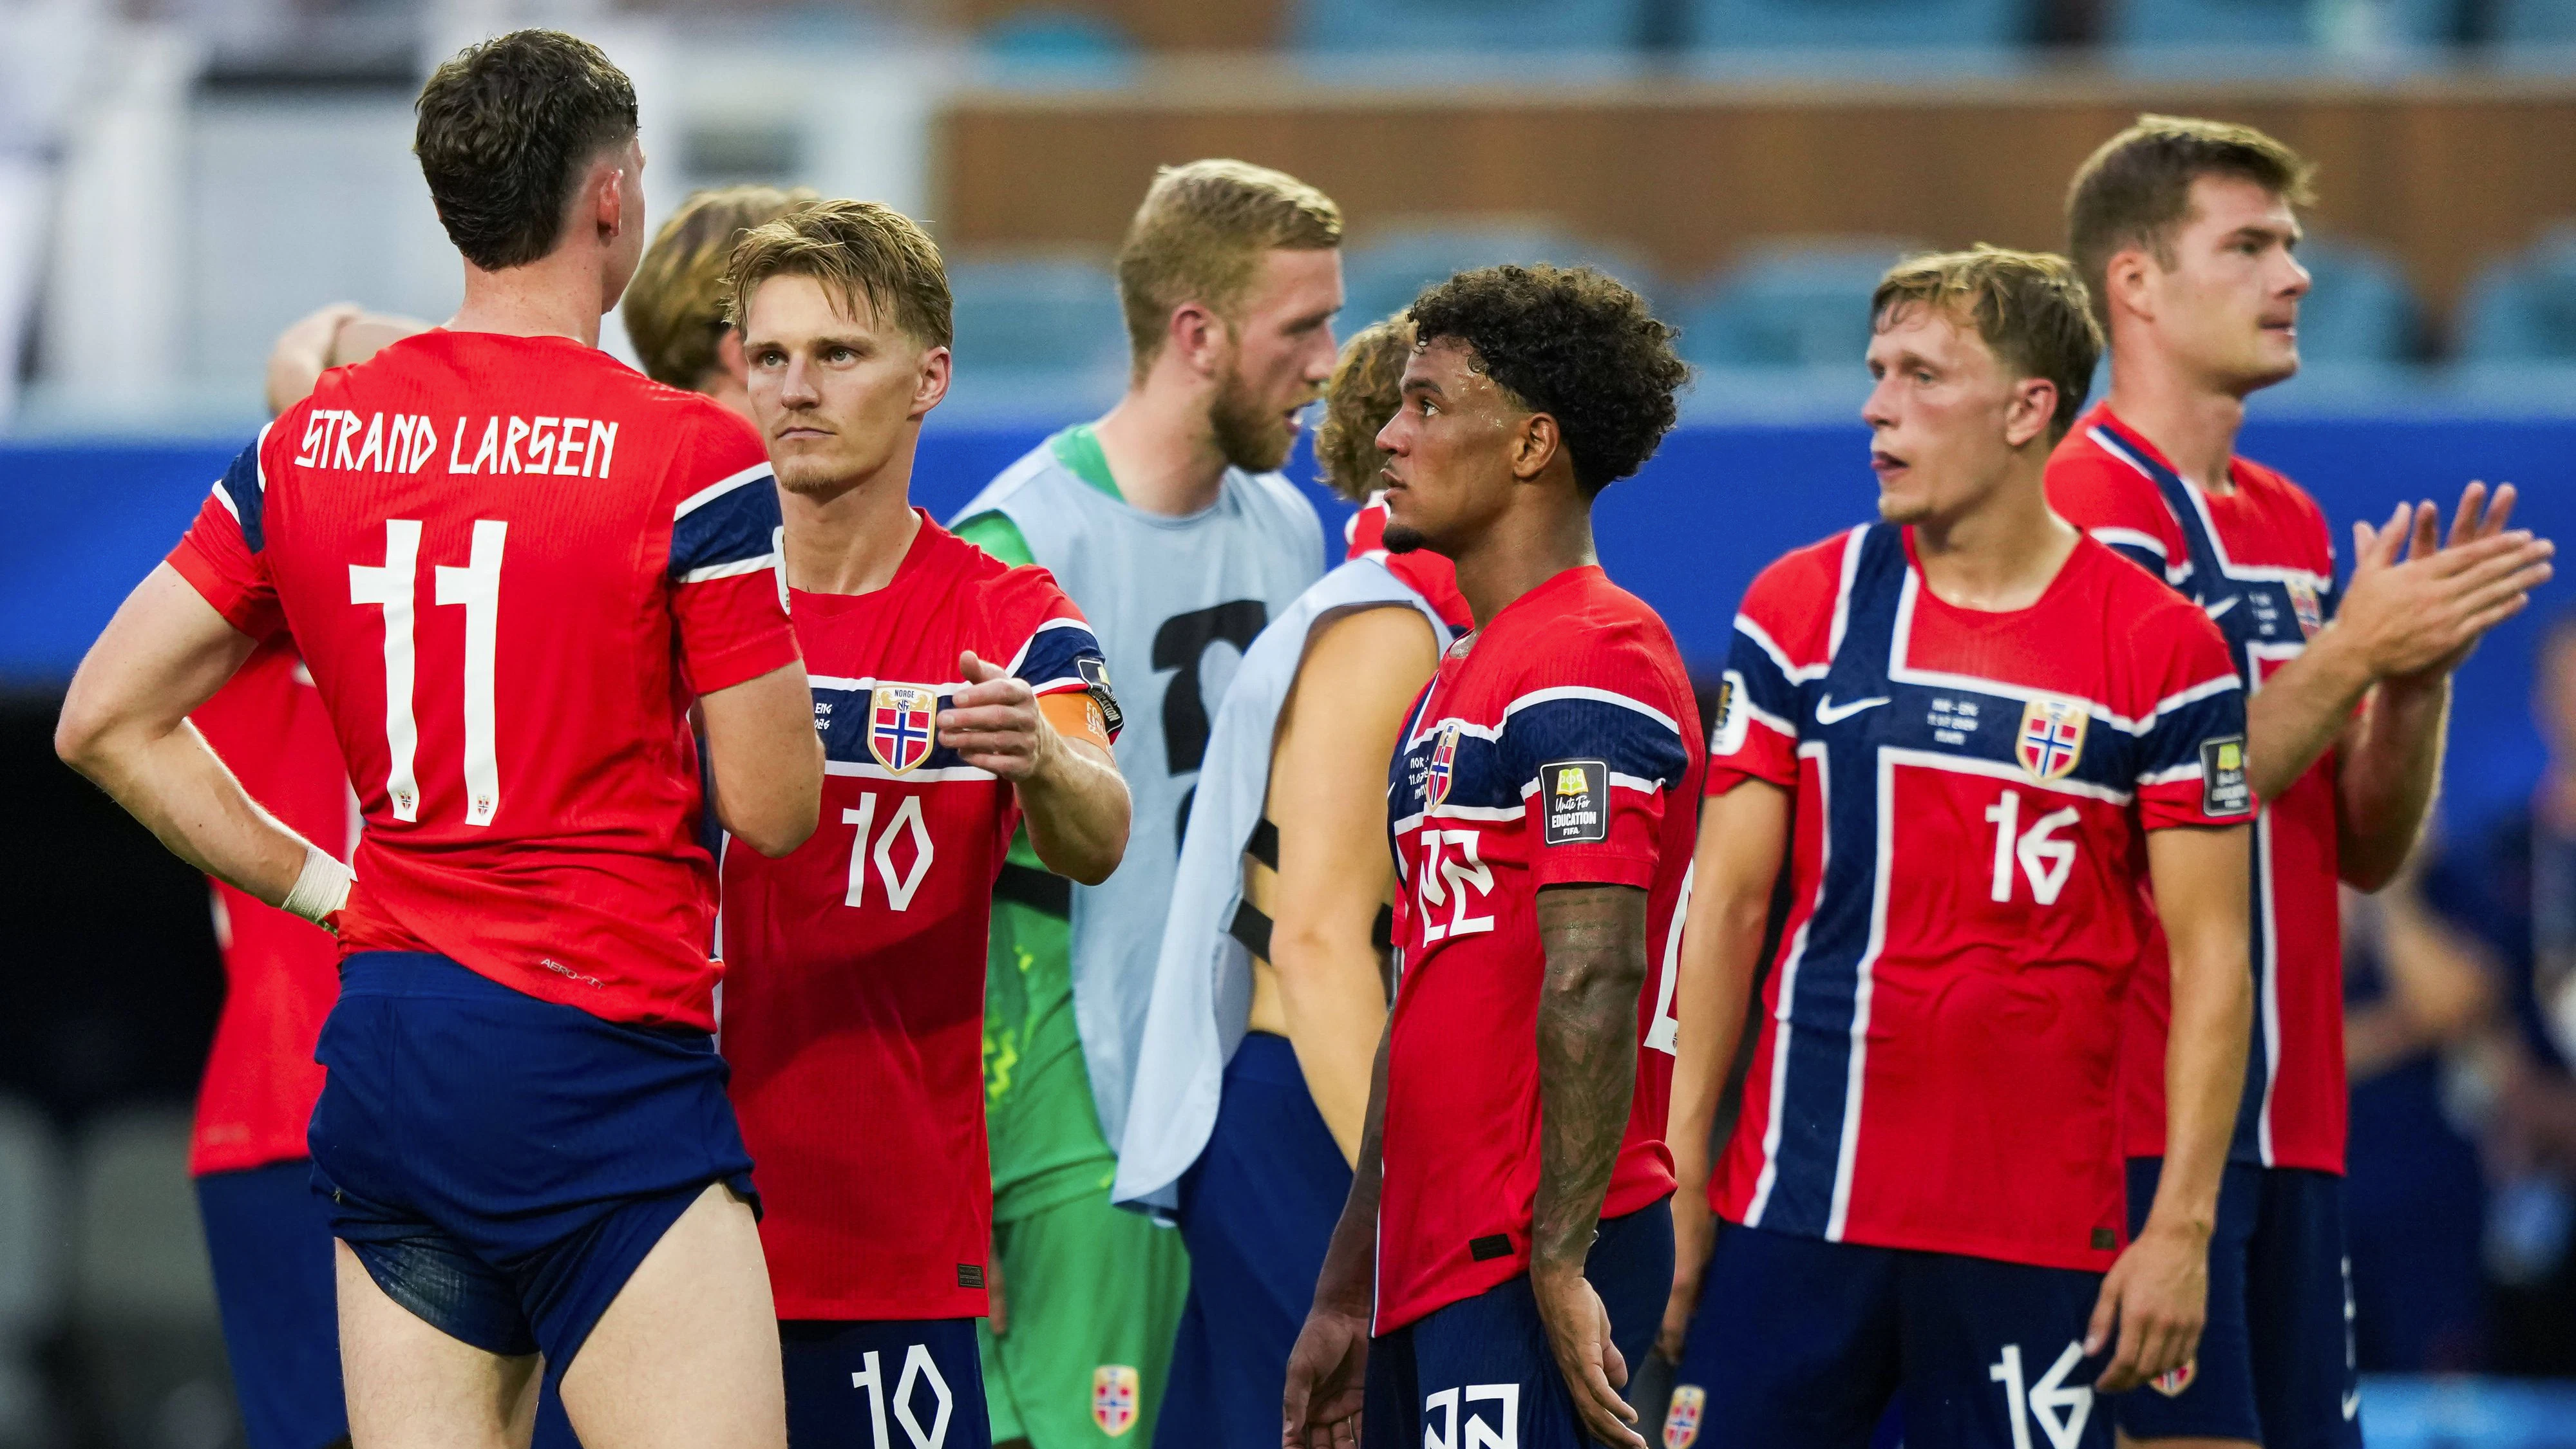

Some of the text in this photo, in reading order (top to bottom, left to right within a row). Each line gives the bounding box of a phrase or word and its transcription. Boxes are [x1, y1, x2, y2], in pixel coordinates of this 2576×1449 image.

[294, 410, 620, 479] STRAND LARSEN
[348, 518, 508, 827] 11
[895, 690, 914, 698] NORGE
[815, 703, 832, 714] ENG
[1410, 757, 1424, 769] NOR
[1551, 811, 1596, 828] EDUCATION
[1555, 795, 1591, 813] Unite For
[1563, 827, 1581, 836] FIFA
[842, 791, 934, 911] 10
[1985, 789, 2081, 905] 16
[1419, 829, 1494, 948] 22
[851, 1344, 953, 1449] 10
[1989, 1340, 2094, 1449] 16
